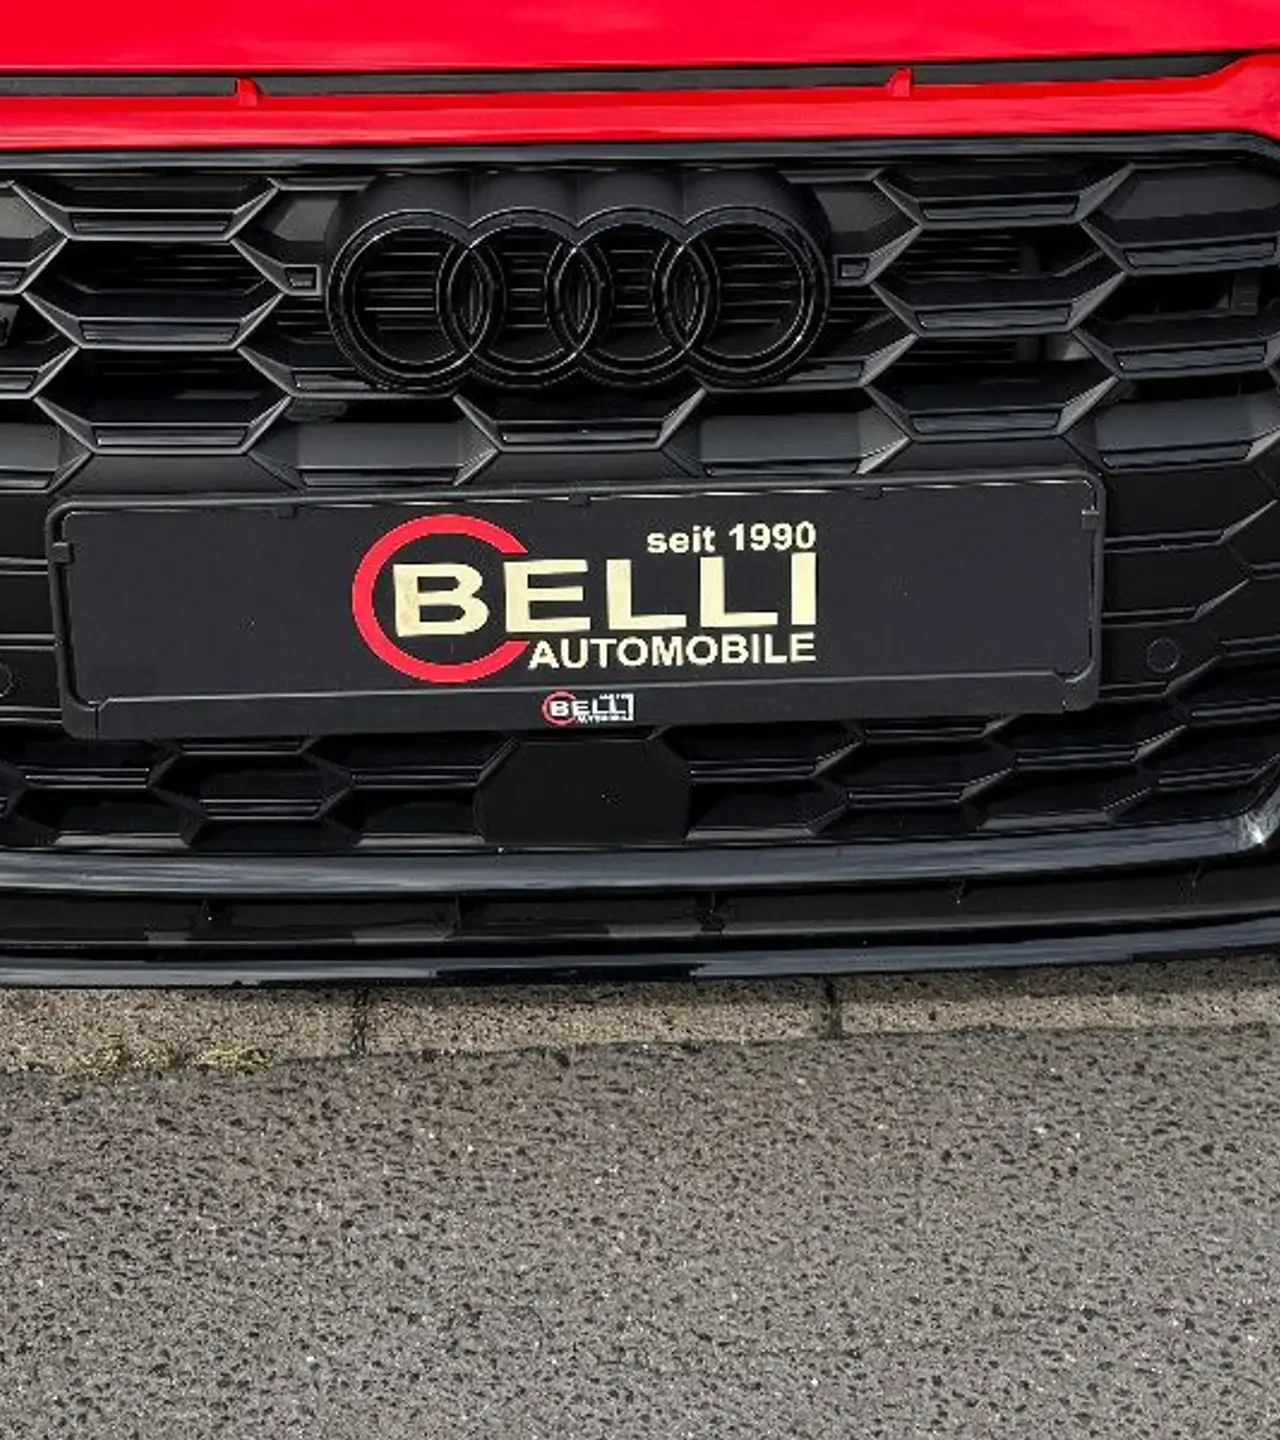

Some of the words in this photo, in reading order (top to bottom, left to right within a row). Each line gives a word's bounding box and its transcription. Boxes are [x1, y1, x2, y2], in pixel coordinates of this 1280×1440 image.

[646, 525, 716, 554] seit
[728, 521, 817, 552] 1990
[392, 552, 817, 638] BELLI
[528, 632, 817, 669] AUTOMOBILE
